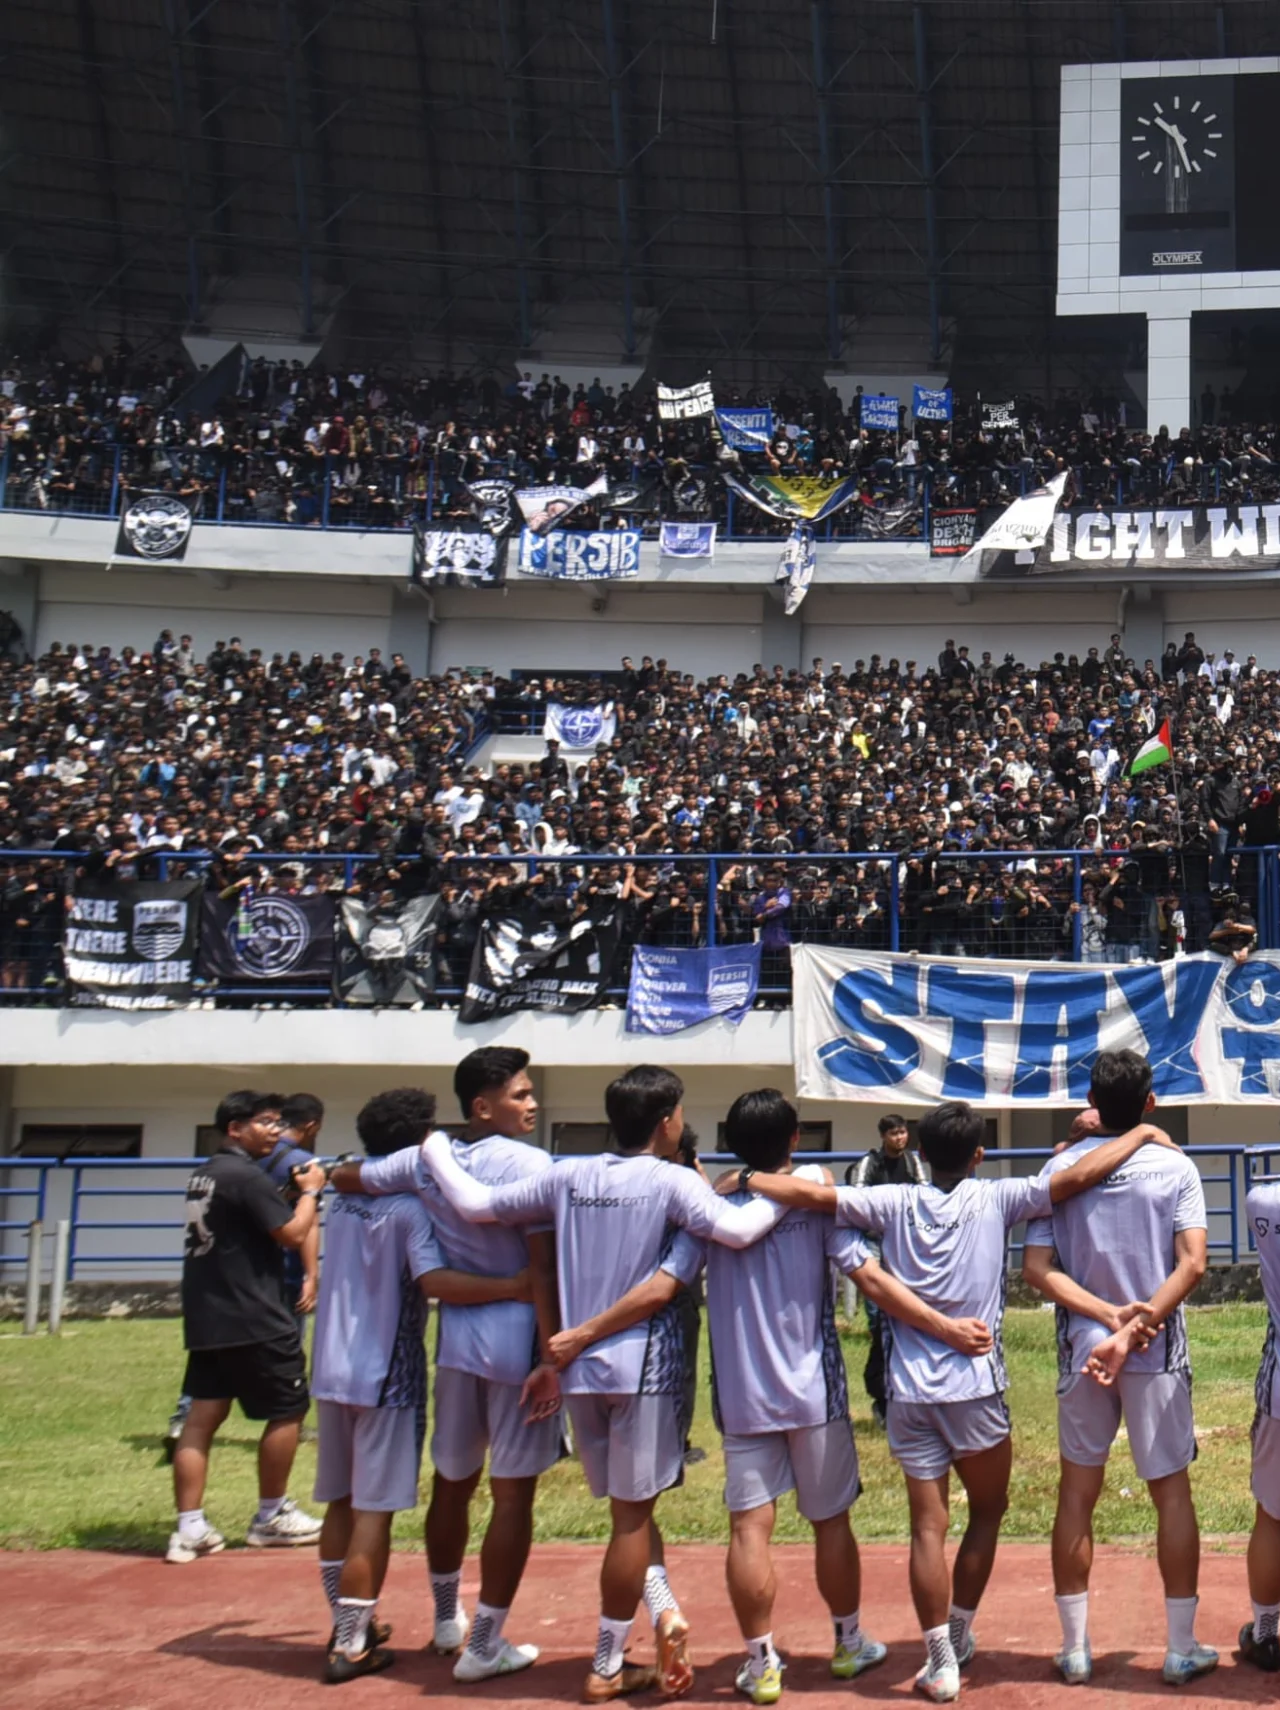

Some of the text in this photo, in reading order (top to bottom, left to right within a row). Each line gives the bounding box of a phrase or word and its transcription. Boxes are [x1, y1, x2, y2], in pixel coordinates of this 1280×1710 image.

[1152, 252, 1203, 264] OLYMPEX
[917, 406, 948, 420] ULTRA
[990, 411, 1010, 422] PER
[1015, 509, 1194, 565] IGHT
[520, 529, 639, 577] PERSIB
[712, 969, 749, 981] PERSIB
[560, 980, 599, 995] BACK
[816, 960, 1224, 1100] STAY
